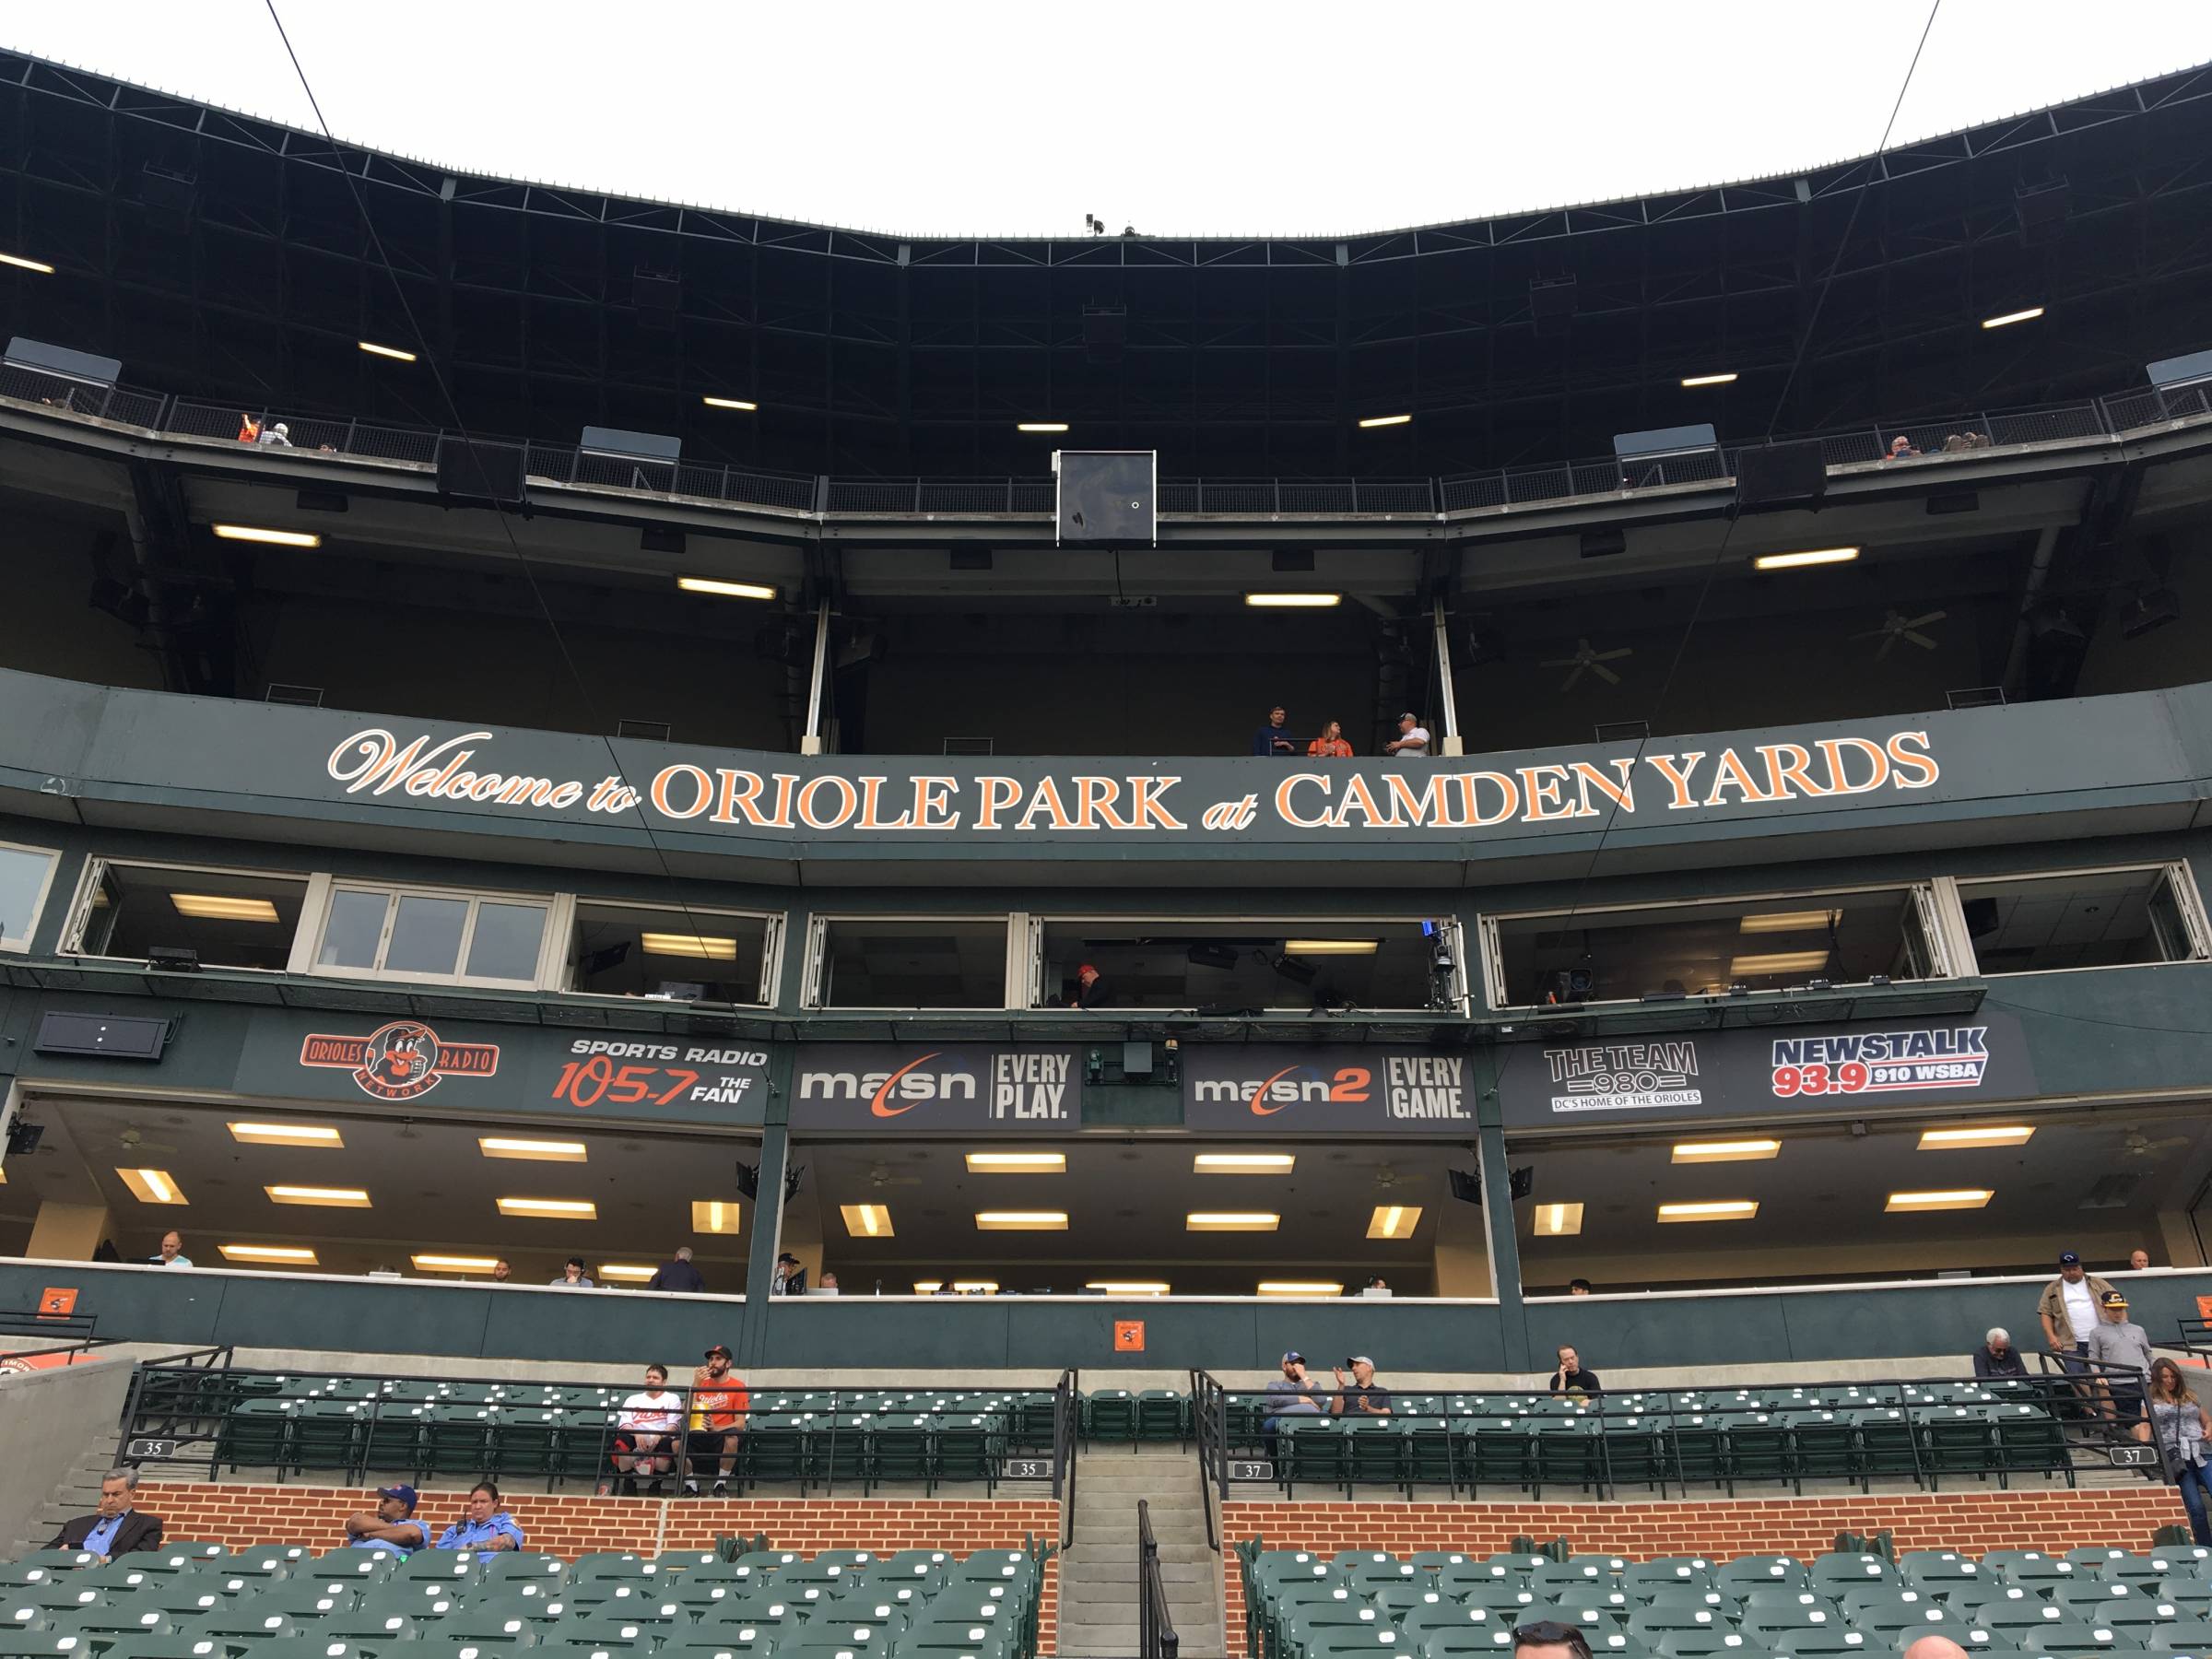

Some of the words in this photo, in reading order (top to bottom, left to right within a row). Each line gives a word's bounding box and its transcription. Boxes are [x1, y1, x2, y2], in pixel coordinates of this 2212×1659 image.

[327, 728, 582, 809] Welcome
[587, 775, 641, 814] to
[651, 764, 961, 830] ORIOLE
[972, 775, 1188, 830] PARK
[1202, 793, 1259, 830] at
[1276, 758, 1635, 828] CAMDEN
[1645, 731, 1939, 809] YARDS
[310, 1041, 362, 1062] ORIOLES
[439, 1049, 489, 1069] RADIO
[571, 1039, 677, 1060] SPORTS
[685, 1048, 768, 1066] RADIO
[1772, 1027, 1989, 1066] NEWSTALK
[997, 1053, 1071, 1083] EVERY
[1389, 1057, 1463, 1087] EVERY
[1544, 1047, 1606, 1082] THE
[1606, 1041, 1699, 1076] TEAM
[1875, 1066, 1911, 1083] 910
[1915, 1063, 1978, 1080] WSBA
[357, 1071, 435, 1097] NETWORK
[720, 1077, 752, 1088] THE
[800, 1072, 975, 1100] masn
[1594, 1071, 1659, 1095] 980
[1772, 1062, 1870, 1098] 93.9
[690, 1087, 742, 1104] FAN
[995, 1084, 1068, 1119] PLAY.
[1392, 1088, 1472, 1119] GAME.
[1554, 1099, 1578, 1110] DC'S
[1581, 1097, 1612, 1108] HOME
[1615, 1096, 1629, 1106] OF
[1630, 1095, 1653, 1105] THE
[1654, 1092, 1700, 1104] ORIOLES
[144, 1441, 163, 1455] 35
[2124, 1450, 2140, 1463] 37
[1020, 1463, 1036, 1476] 35
[1245, 1465, 1261, 1477] 37
